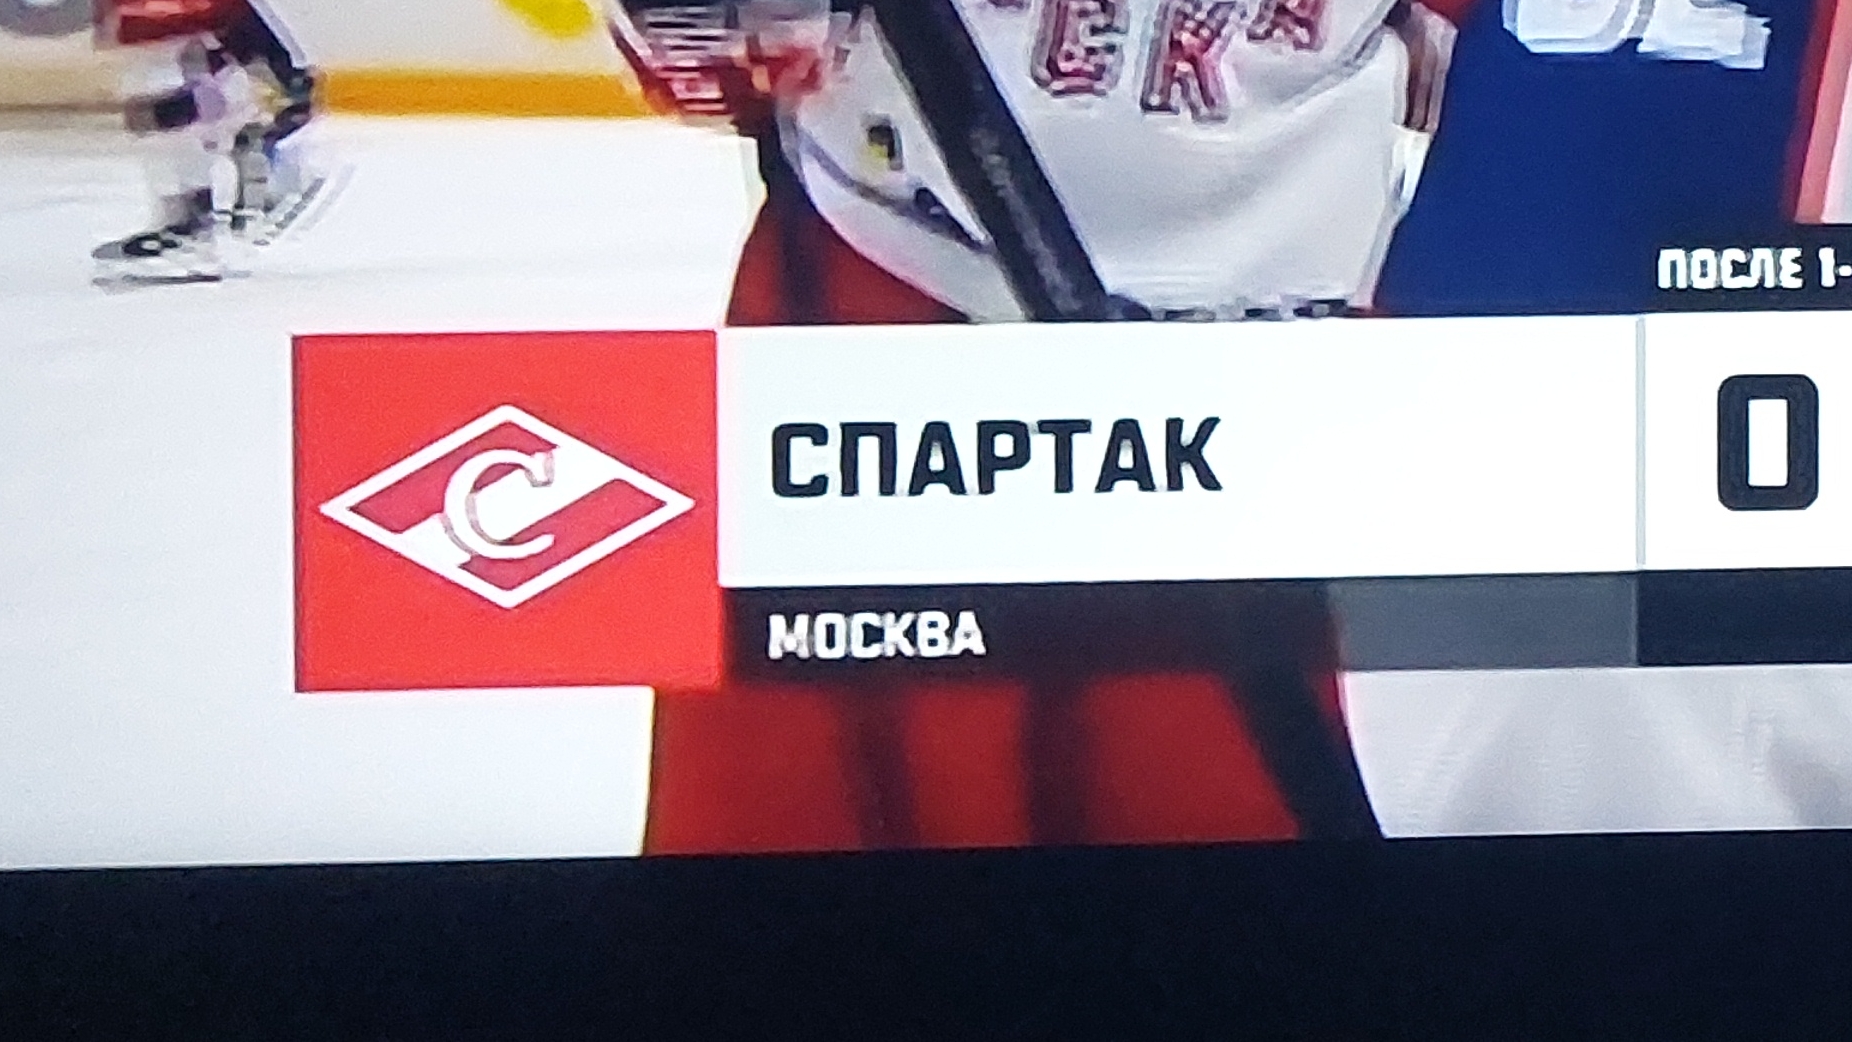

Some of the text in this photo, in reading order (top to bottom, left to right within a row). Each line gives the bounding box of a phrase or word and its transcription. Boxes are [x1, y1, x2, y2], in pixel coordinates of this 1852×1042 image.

[1657, 247, 1804, 290] ПОСЛЕ
[771, 416, 1223, 499] СПАРТАК
[1716, 373, 1820, 512] 0
[767, 610, 987, 661] МОСКВА
